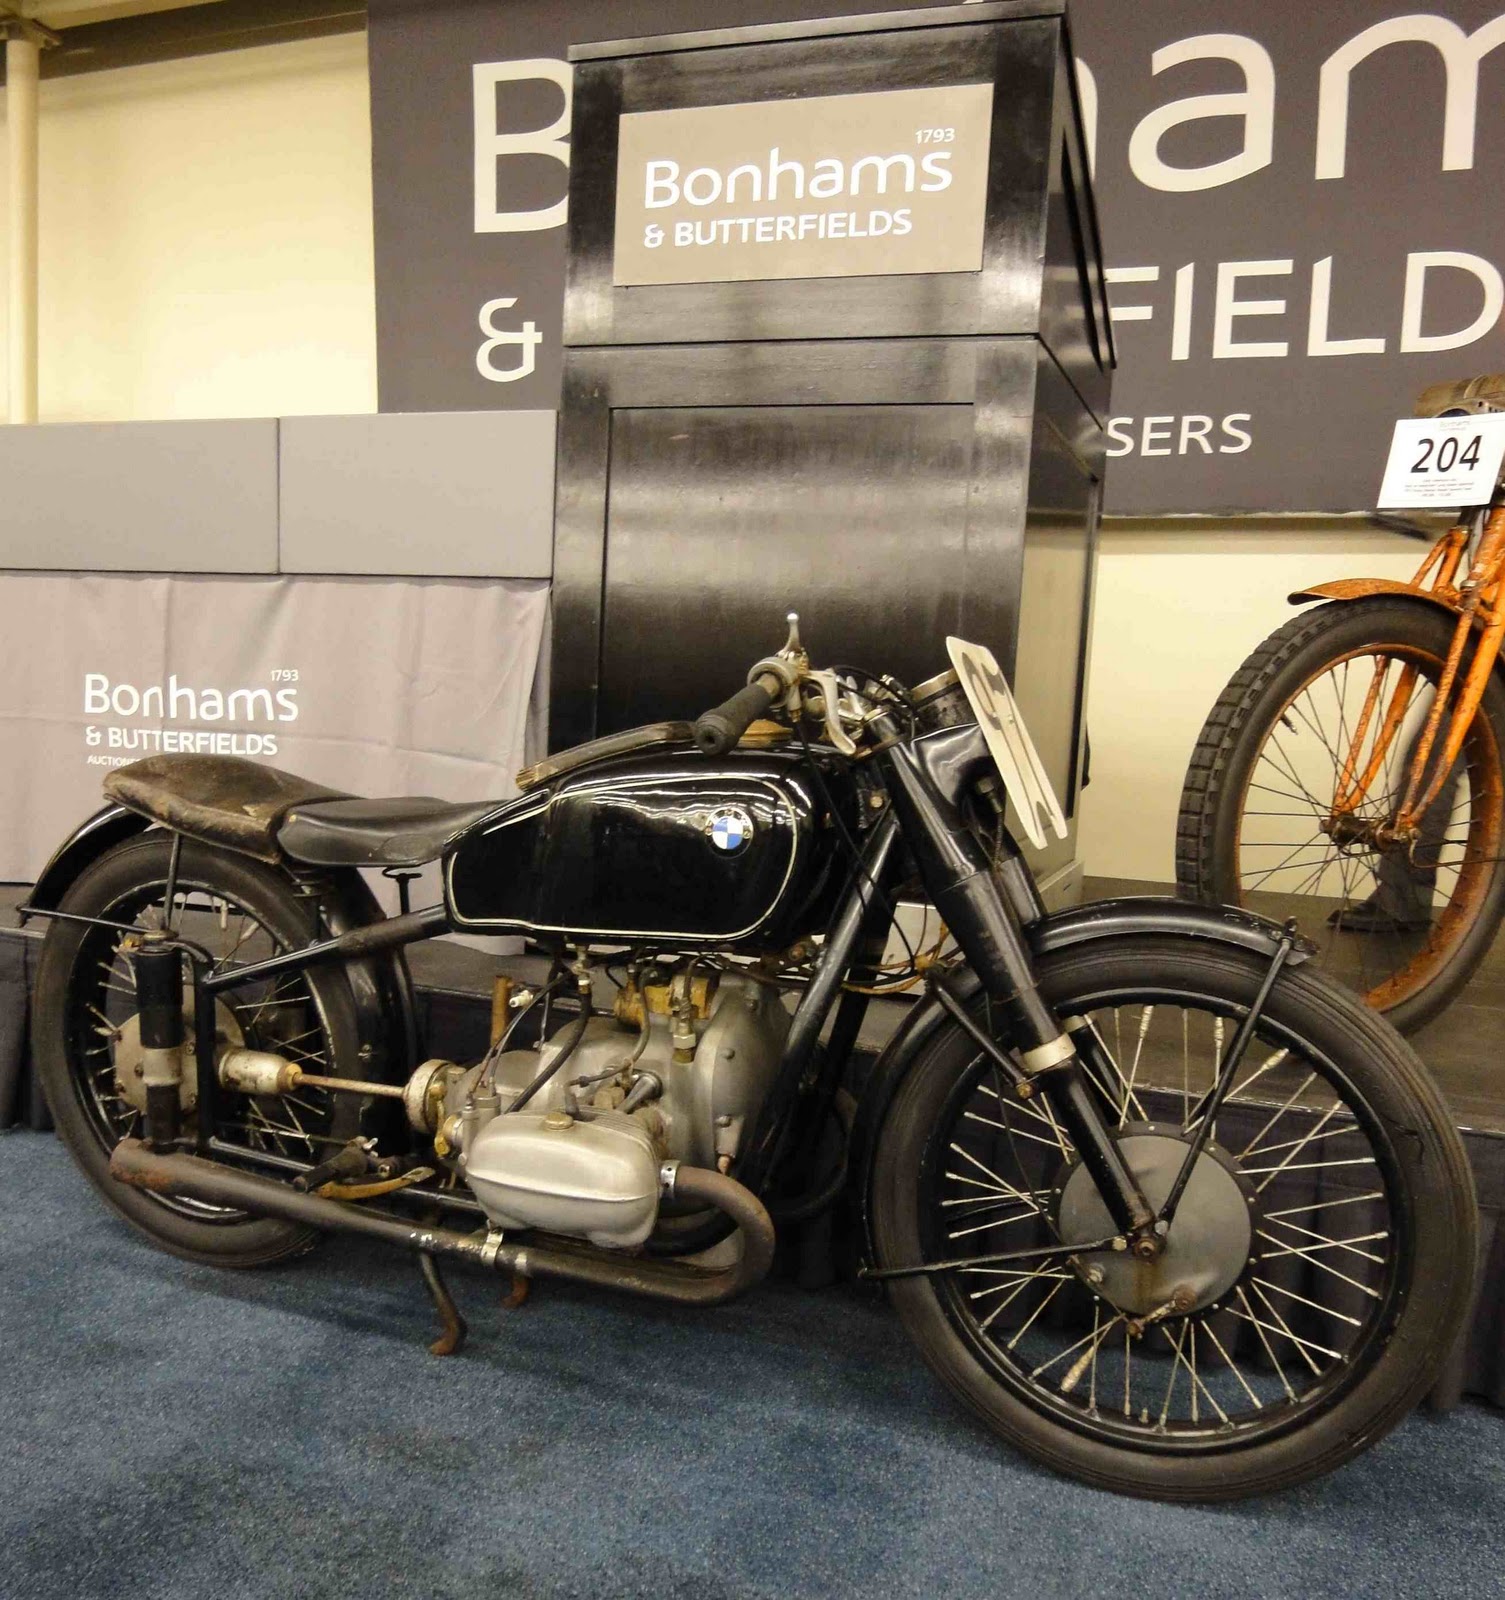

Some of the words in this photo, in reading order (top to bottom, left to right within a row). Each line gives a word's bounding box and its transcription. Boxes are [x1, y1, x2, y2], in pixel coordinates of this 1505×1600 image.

[915, 127, 956, 144] 1793
[644, 146, 953, 209] Bonhams
[643, 223, 665, 249] &
[674, 208, 913, 247] BUTTERFIELDS
[475, 297, 543, 383] &
[1410, 435, 1483, 474] 204
[270, 669, 300, 682] 1793
[84, 673, 299, 722] Bonhams
[86, 726, 102, 746] &
[108, 727, 278, 756] BUTTERFIELDS
